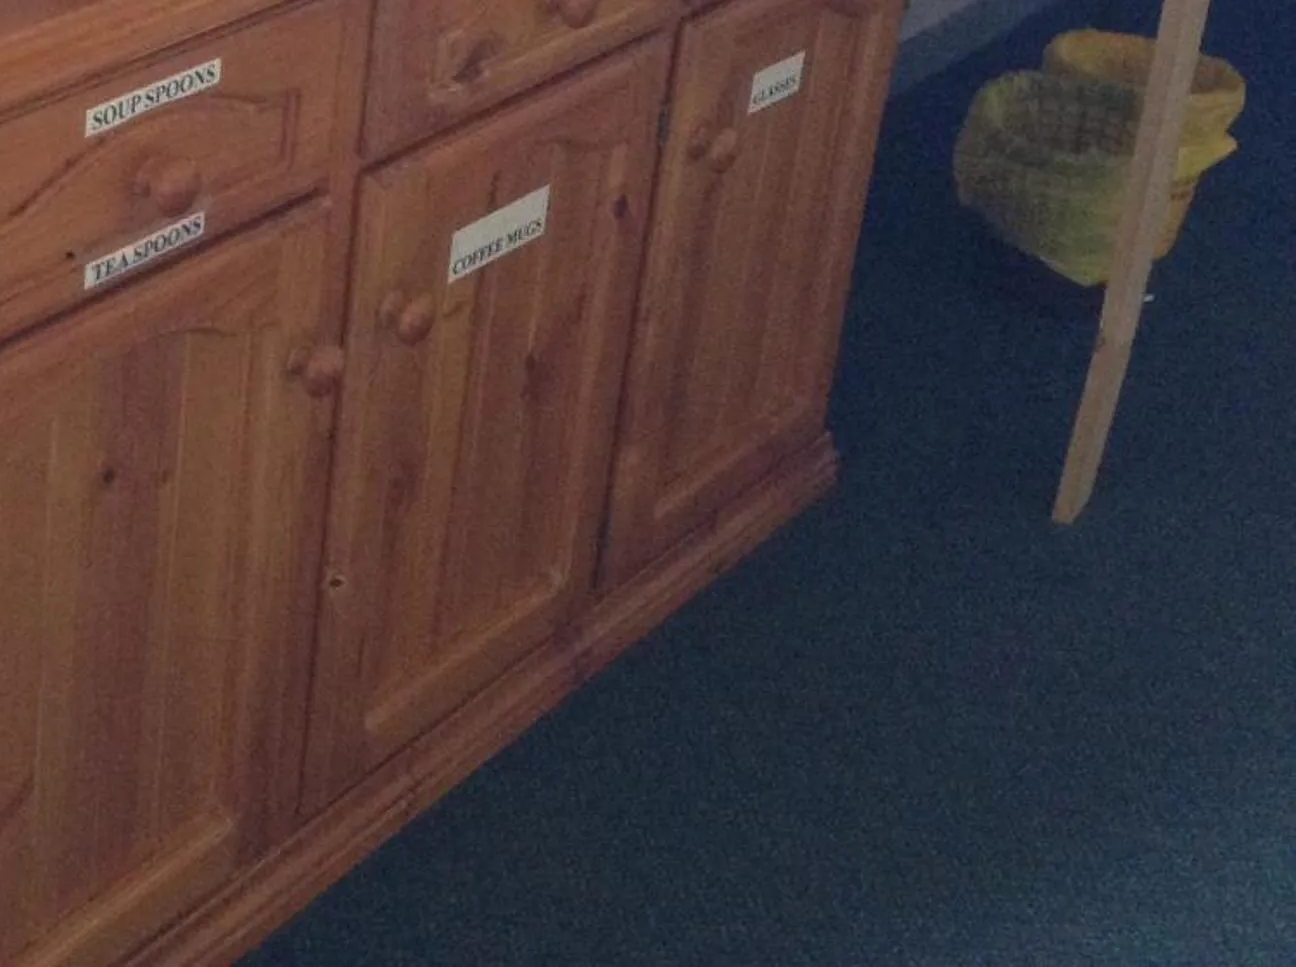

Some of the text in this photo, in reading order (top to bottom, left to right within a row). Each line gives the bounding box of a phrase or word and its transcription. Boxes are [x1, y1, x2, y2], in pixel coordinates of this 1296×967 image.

[91, 64, 216, 131] SOUP SPOONS
[92, 215, 202, 281] TEA SPOONS
[452, 218, 544, 274] COFFEE MUGS
